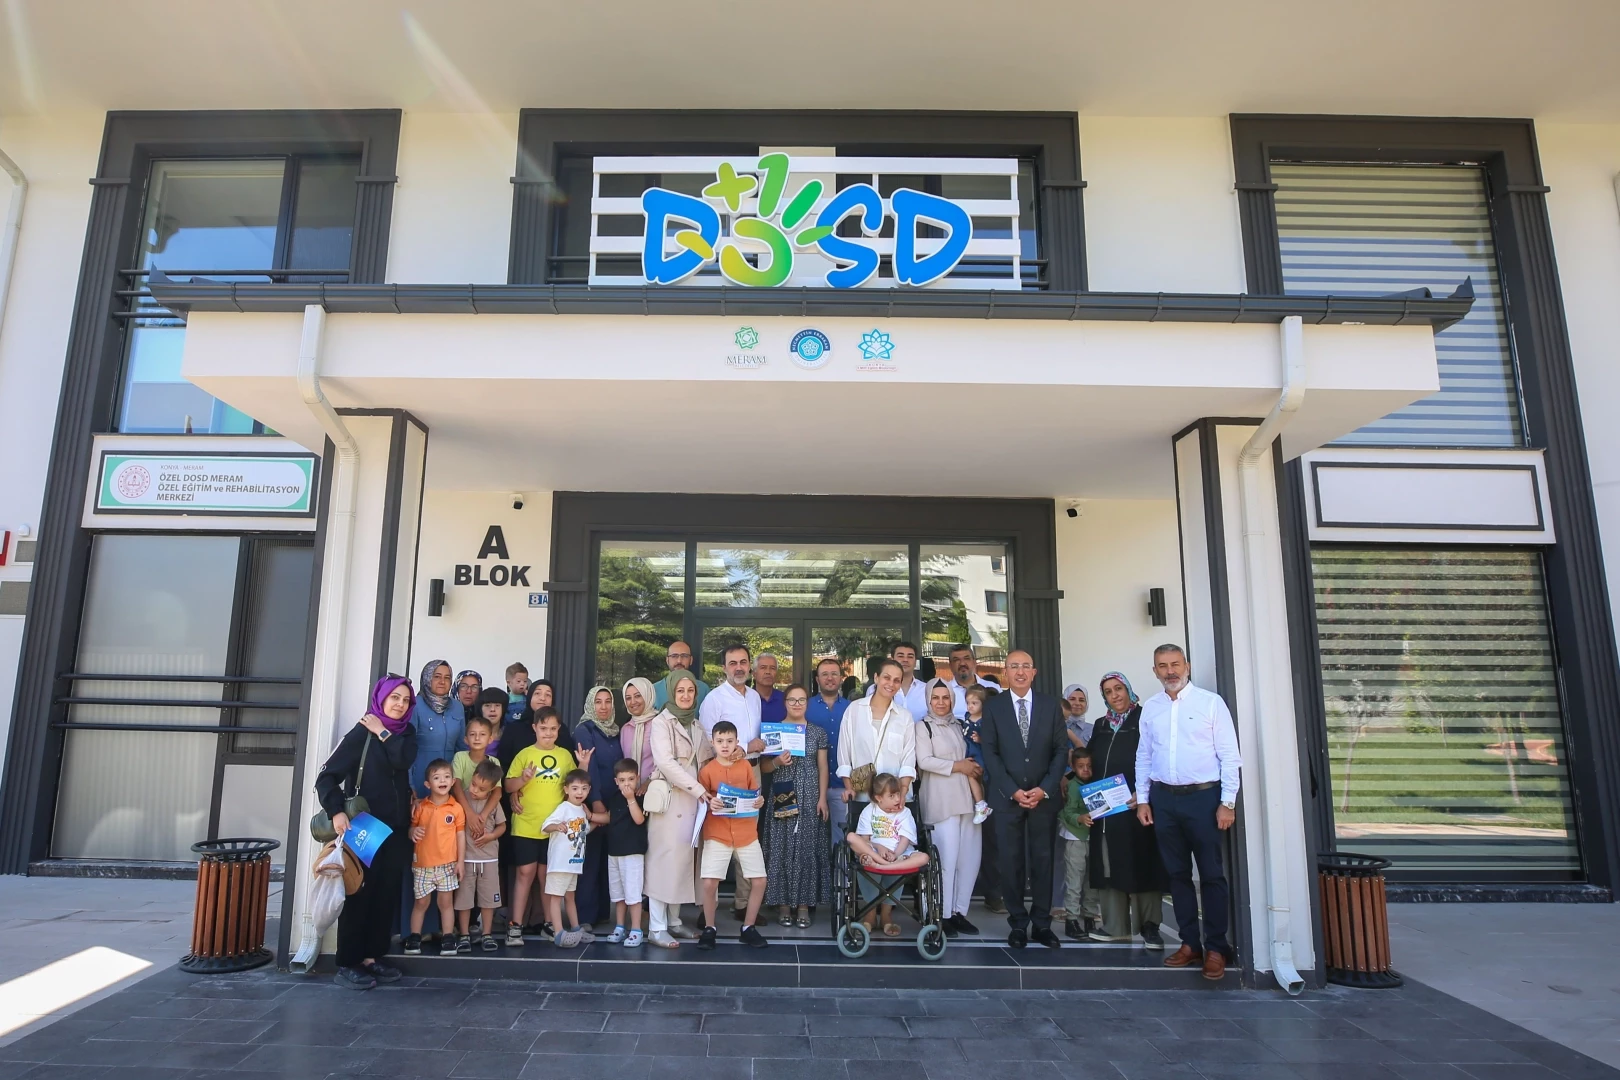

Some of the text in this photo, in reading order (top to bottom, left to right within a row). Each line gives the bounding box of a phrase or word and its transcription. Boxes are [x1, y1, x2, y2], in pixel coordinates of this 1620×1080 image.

[641, 186, 973, 289] DOSD
[726, 355, 767, 364] MERAM
[159, 472, 243, 483] ÖZEL DOSD MERAM
[158, 482, 180, 492] ÖZEL
[181, 482, 212, 493] EĞİTİM
[225, 484, 300, 494] REHABİLİTASYON
[156, 492, 195, 502] MERKEZİ
[477, 525, 510, 559] A
[454, 564, 531, 587] BLOK
[531, 595, 540, 605] 8
